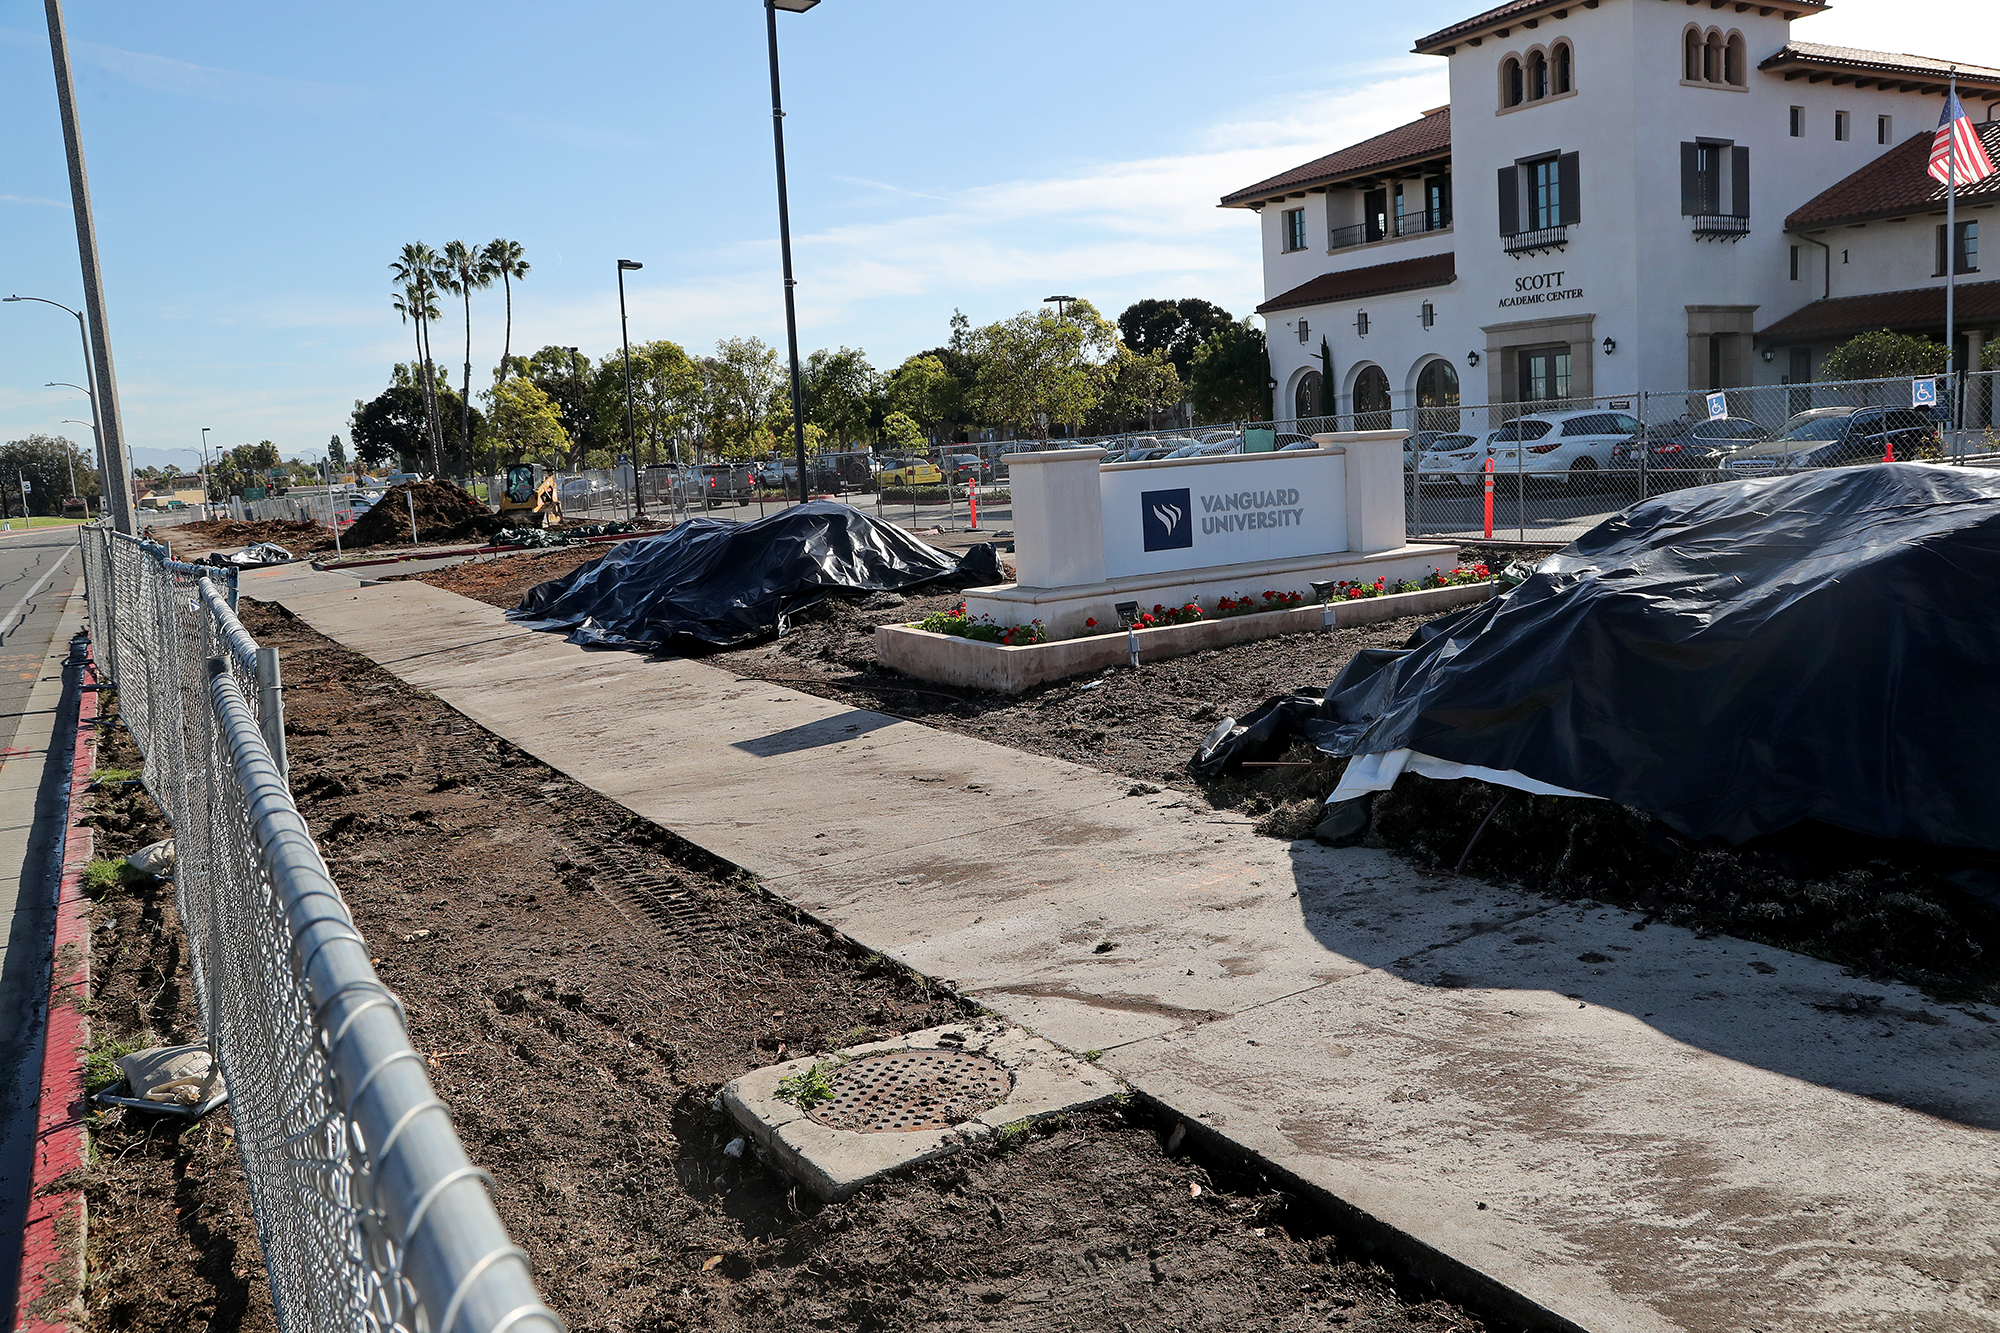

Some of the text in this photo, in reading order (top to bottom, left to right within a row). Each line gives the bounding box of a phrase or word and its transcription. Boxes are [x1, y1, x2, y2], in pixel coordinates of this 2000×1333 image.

[1842, 249, 1850, 264] 1
[1515, 271, 1565, 292] SCOTT
[1498, 288, 1584, 308] ACADEMIC CENTER
[1200, 488, 1300, 513] VANGUARD
[1201, 508, 1304, 535] UNIVERSITY
